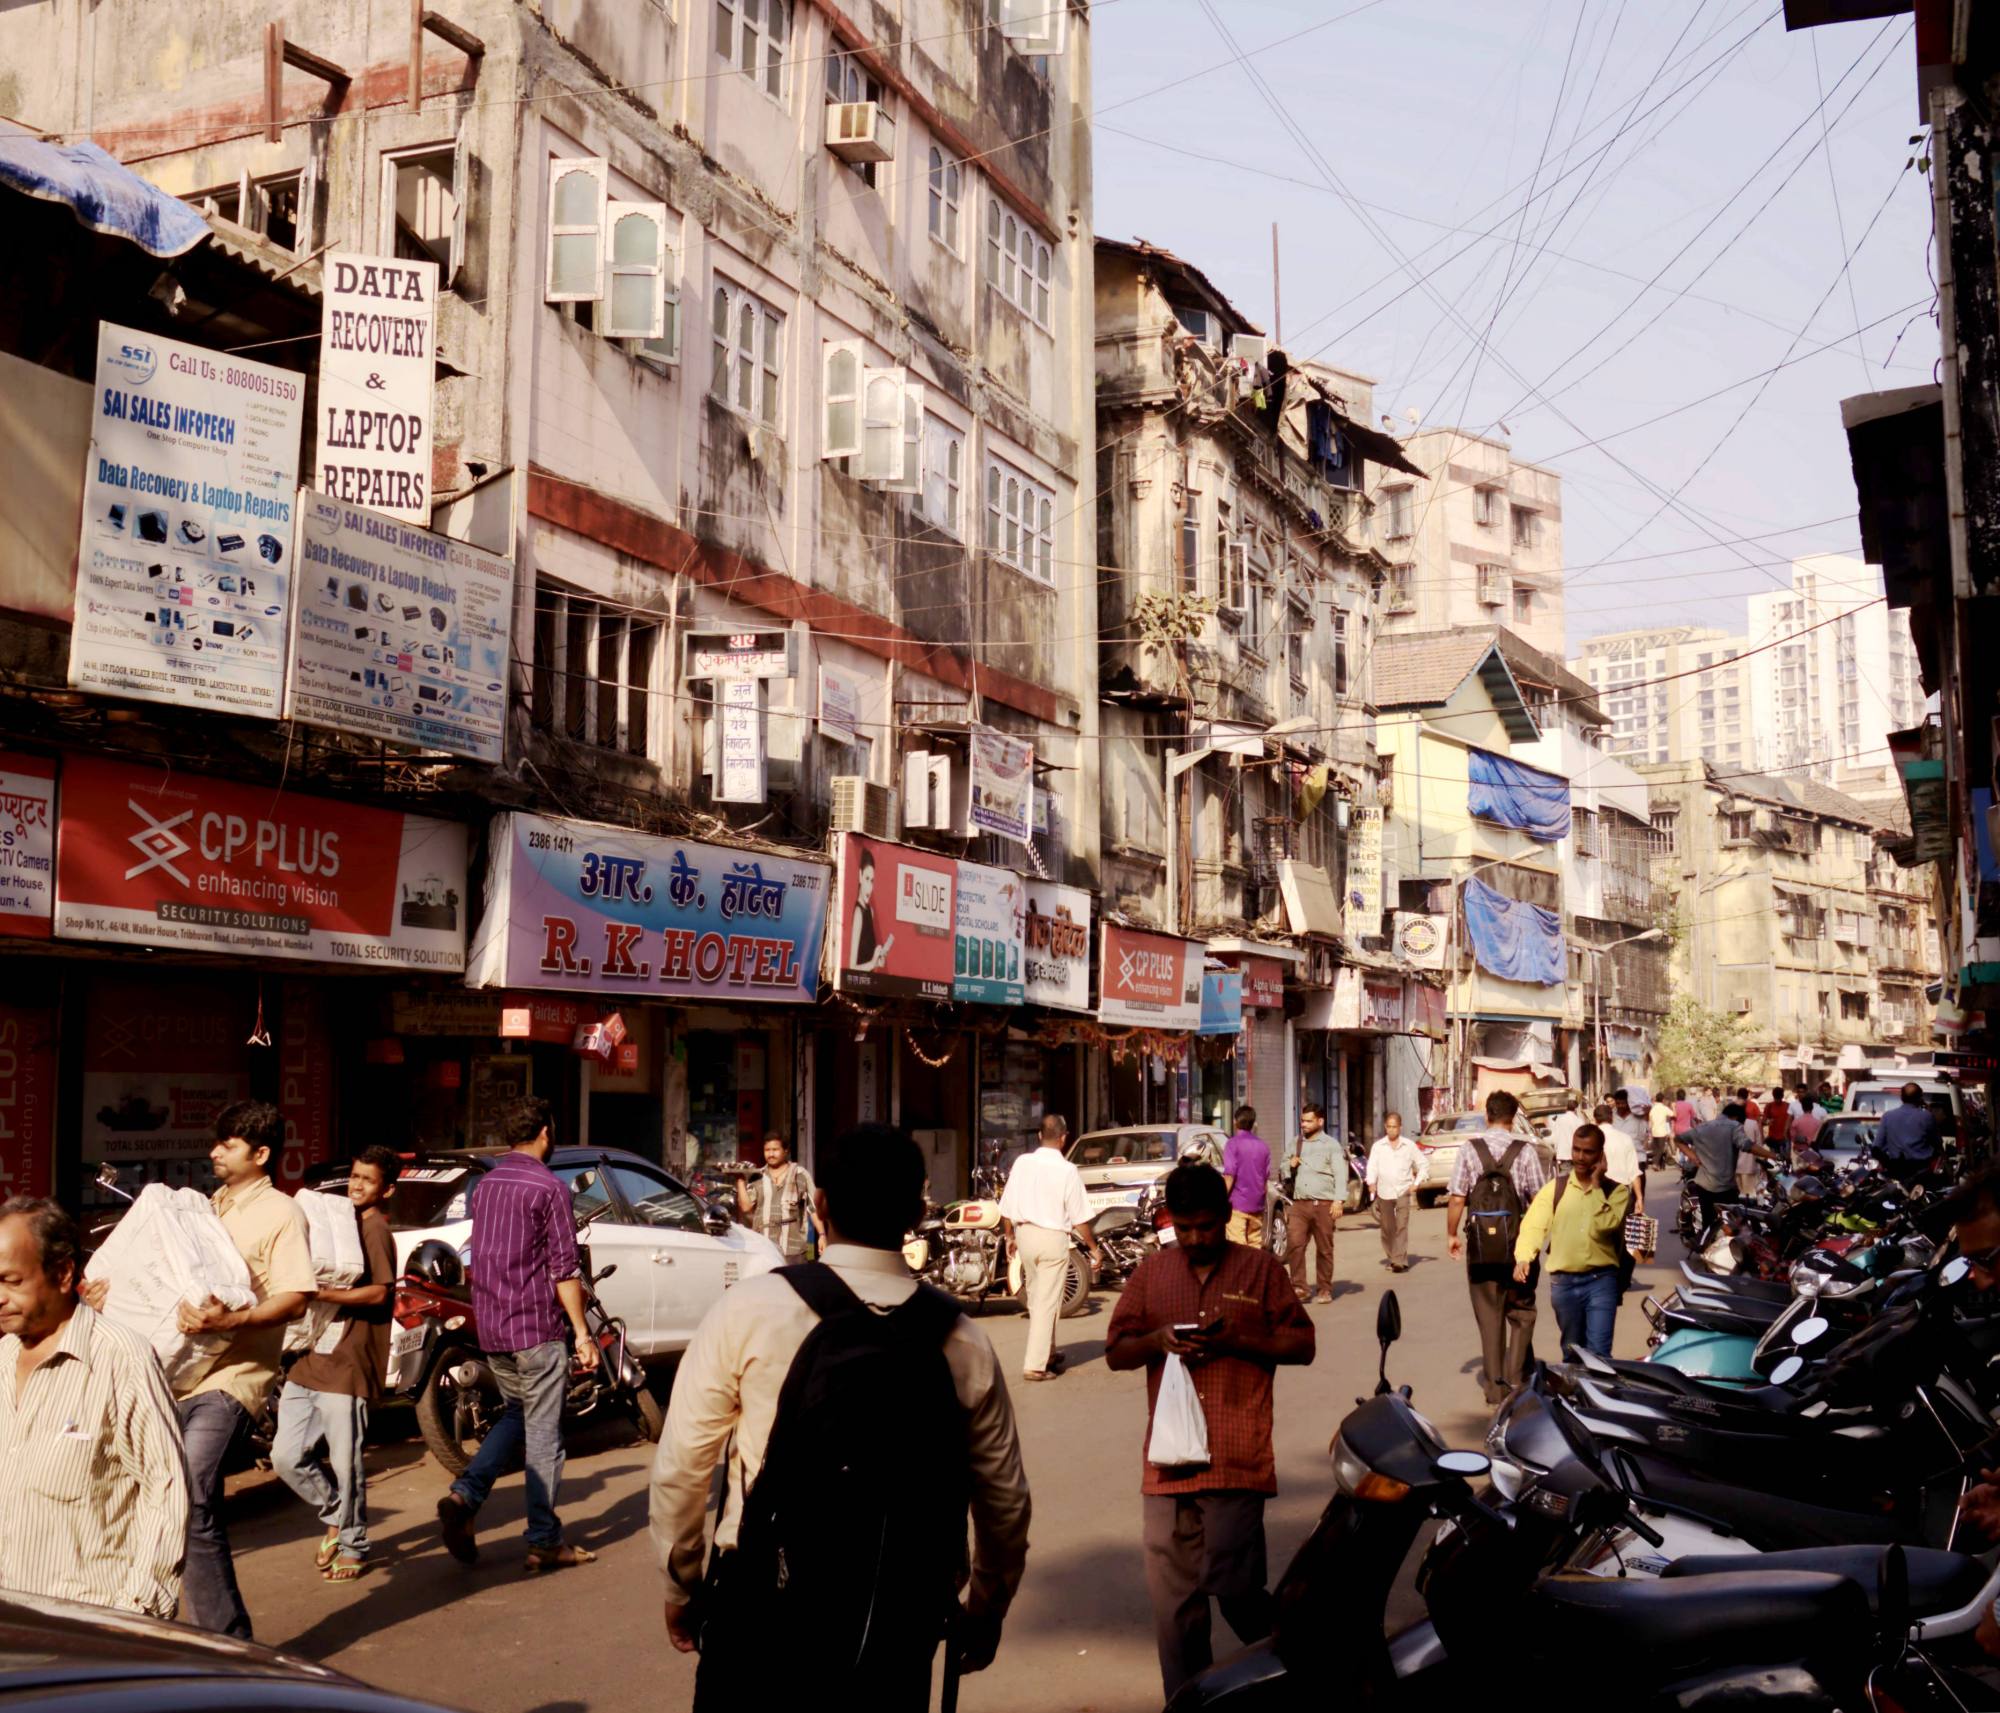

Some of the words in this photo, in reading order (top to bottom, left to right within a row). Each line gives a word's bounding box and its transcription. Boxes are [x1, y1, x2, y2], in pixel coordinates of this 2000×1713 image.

[334, 262, 424, 302] DATA
[331, 310, 428, 358] RECOVERY
[121, 345, 152, 363] SSI
[169, 353, 198, 376] Call
[201, 361, 216, 380] Us
[226, 368, 297, 400] 8080051550
[365, 373, 387, 390] &
[103, 388, 128, 419] SAI
[130, 395, 171, 430] SALES
[174, 406, 235, 444] INFOTECH
[327, 407, 422, 454] LAPTOP
[147, 430, 160, 440] One
[161, 433, 177, 446] Stop
[98, 458, 128, 487] Data
[130, 466, 189, 503] Recovery
[191, 484, 200, 499] &
[202, 481, 243, 514] Laptop
[245, 491, 290, 522] Repairs
[323, 465, 425, 510] REPAIRS
[344, 510, 364, 532] SAI
[366, 519, 397, 545] SALES
[400, 529, 447, 561] INFOTECH
[304, 538, 329, 565] Data
[330, 546, 377, 582] Recovery
[379, 567, 386, 581] &
[388, 564, 420, 594] Laptop
[422, 576, 457, 605] Repairs
[450, 548, 464, 565] Call
[200, 812, 247, 863] CP
[256, 820, 340, 877] PLUS
[529, 831, 551, 850] 2386
[553, 836, 573, 854] 1471
[16, 851, 50, 872] Camera
[1350, 867, 1377, 876] IMAC
[13, 875, 46, 892] House,
[198, 870, 287, 907] enhancing
[292, 881, 339, 908] vision
[580, 852, 652, 903] आर.
[670, 850, 706, 909] के.
[720, 862, 787, 920] हॉटेल
[792, 873, 807, 888] 2386
[65, 917, 84, 931] Shop
[85, 918, 95, 930] No
[132, 923, 156, 936] Walker
[156, 925, 180, 940] House,
[180, 928, 212, 942] Tribhuvan
[213, 932, 231, 945] Road,
[232, 933, 265, 948] Lamington
[162, 904, 229, 925] SECURITY
[233, 911, 308, 932] SOLUTIONS
[330, 941, 362, 959] TOTAL
[364, 943, 412, 964] SECURITY
[414, 947, 461, 967] SOLUTION
[540, 915, 591, 974] R.
[602, 922, 651, 979] K.
[659, 927, 800, 988] HOTEL
[1136, 952, 1149, 977] CP
[1150, 953, 1174, 981] PLUS
[1135, 984, 1159, 998] enhancing
[1253, 978, 1269, 995] Alpha
[534, 1003, 560, 1022] airtel
[563, 1006, 577, 1024] 3G
[284, 990, 310, 1106] PLUS
[105, 1139, 133, 1152] TOTAL
[135, 1138, 176, 1151] SECURITY
[282, 1120, 305, 1181] CP
